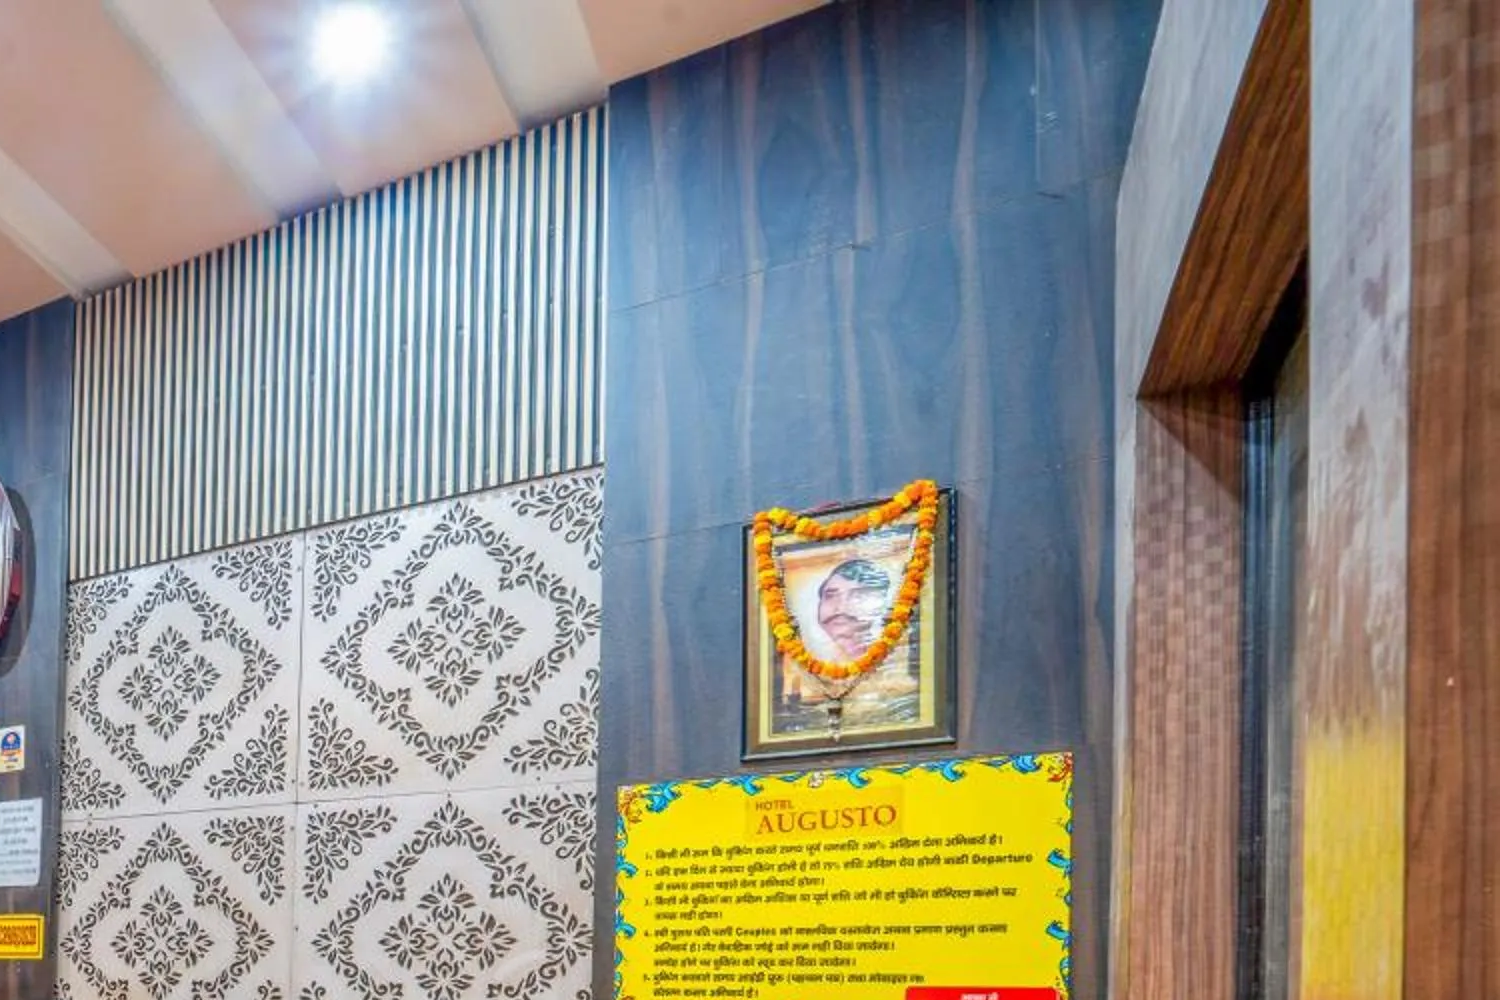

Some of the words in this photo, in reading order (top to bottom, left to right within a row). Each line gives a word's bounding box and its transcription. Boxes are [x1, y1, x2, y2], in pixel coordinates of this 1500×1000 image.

[755, 798, 794, 811] HOTEL
[756, 804, 897, 834] AUGUSTO
[972, 851, 1032, 864] Departure
